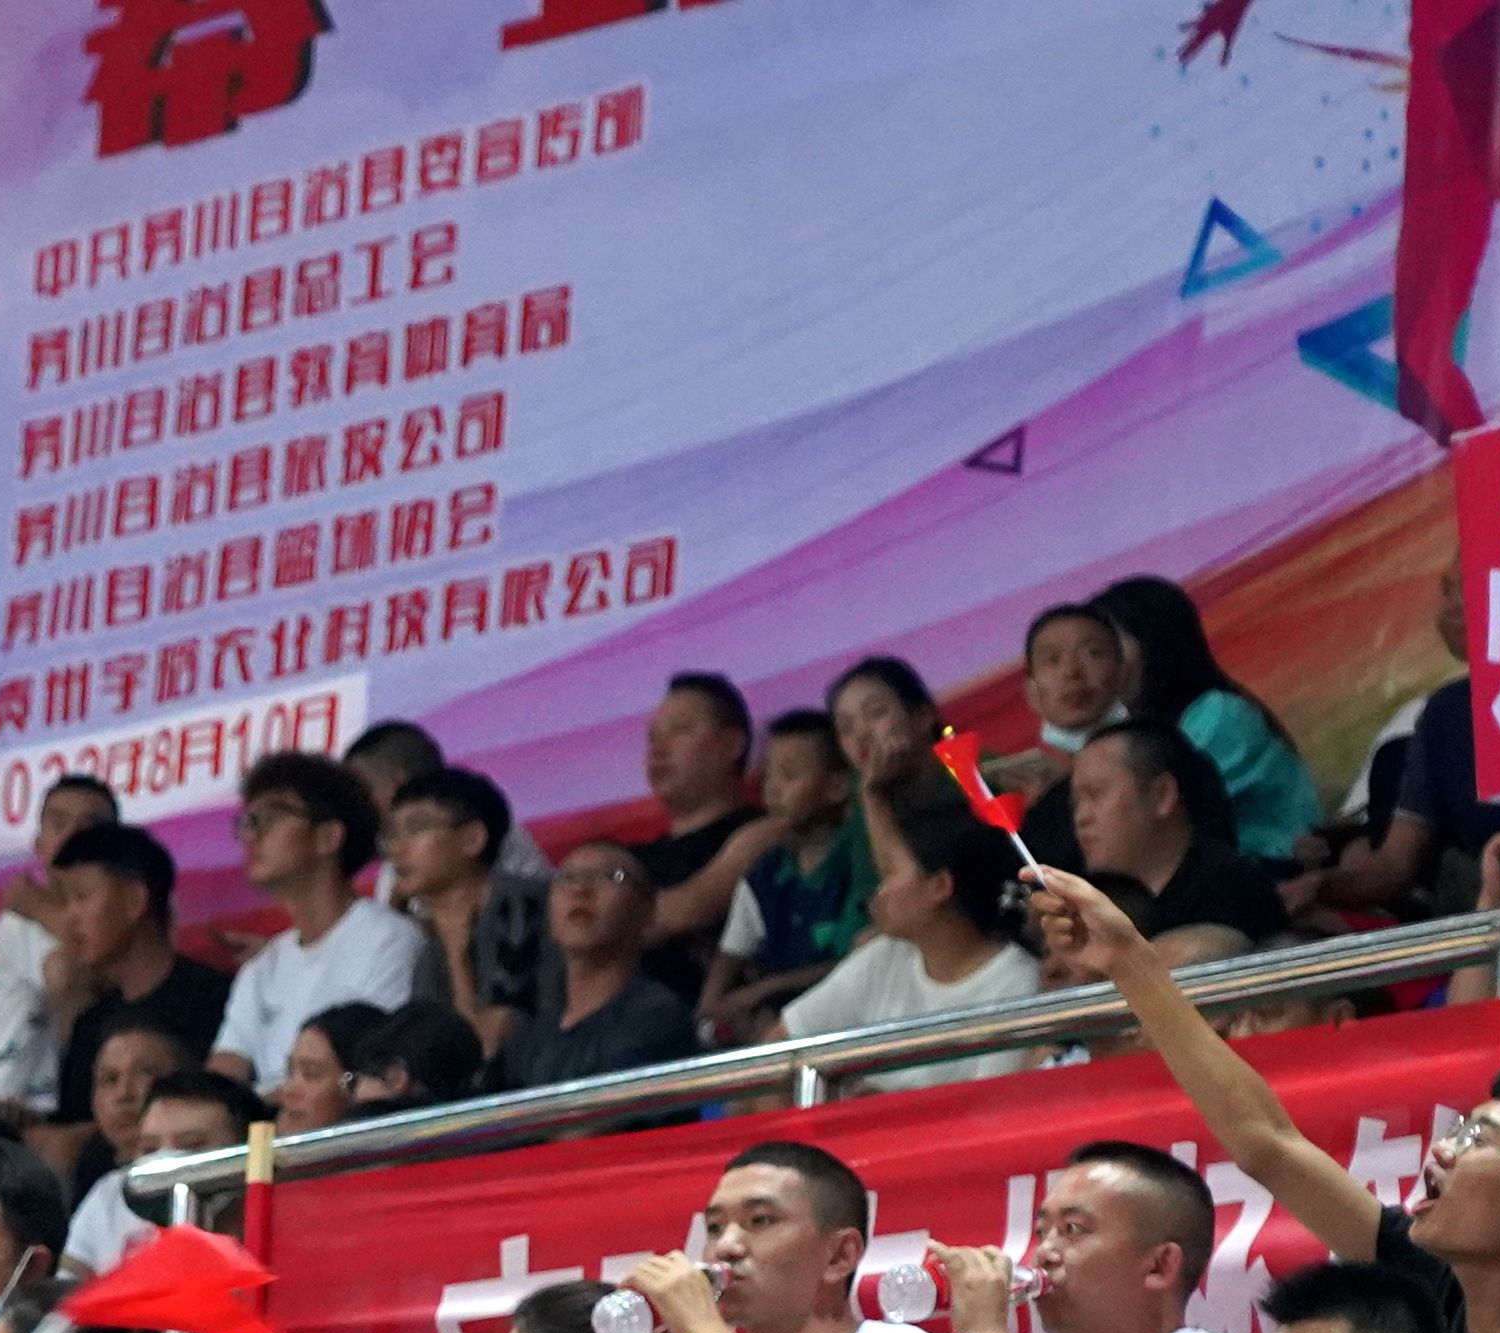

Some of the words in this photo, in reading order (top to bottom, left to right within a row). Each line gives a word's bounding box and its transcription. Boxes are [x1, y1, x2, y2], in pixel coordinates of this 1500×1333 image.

[26, 221, 458, 391] 务川自治县总工会
[1, 482, 497, 653] 务川自治县篮球协会
